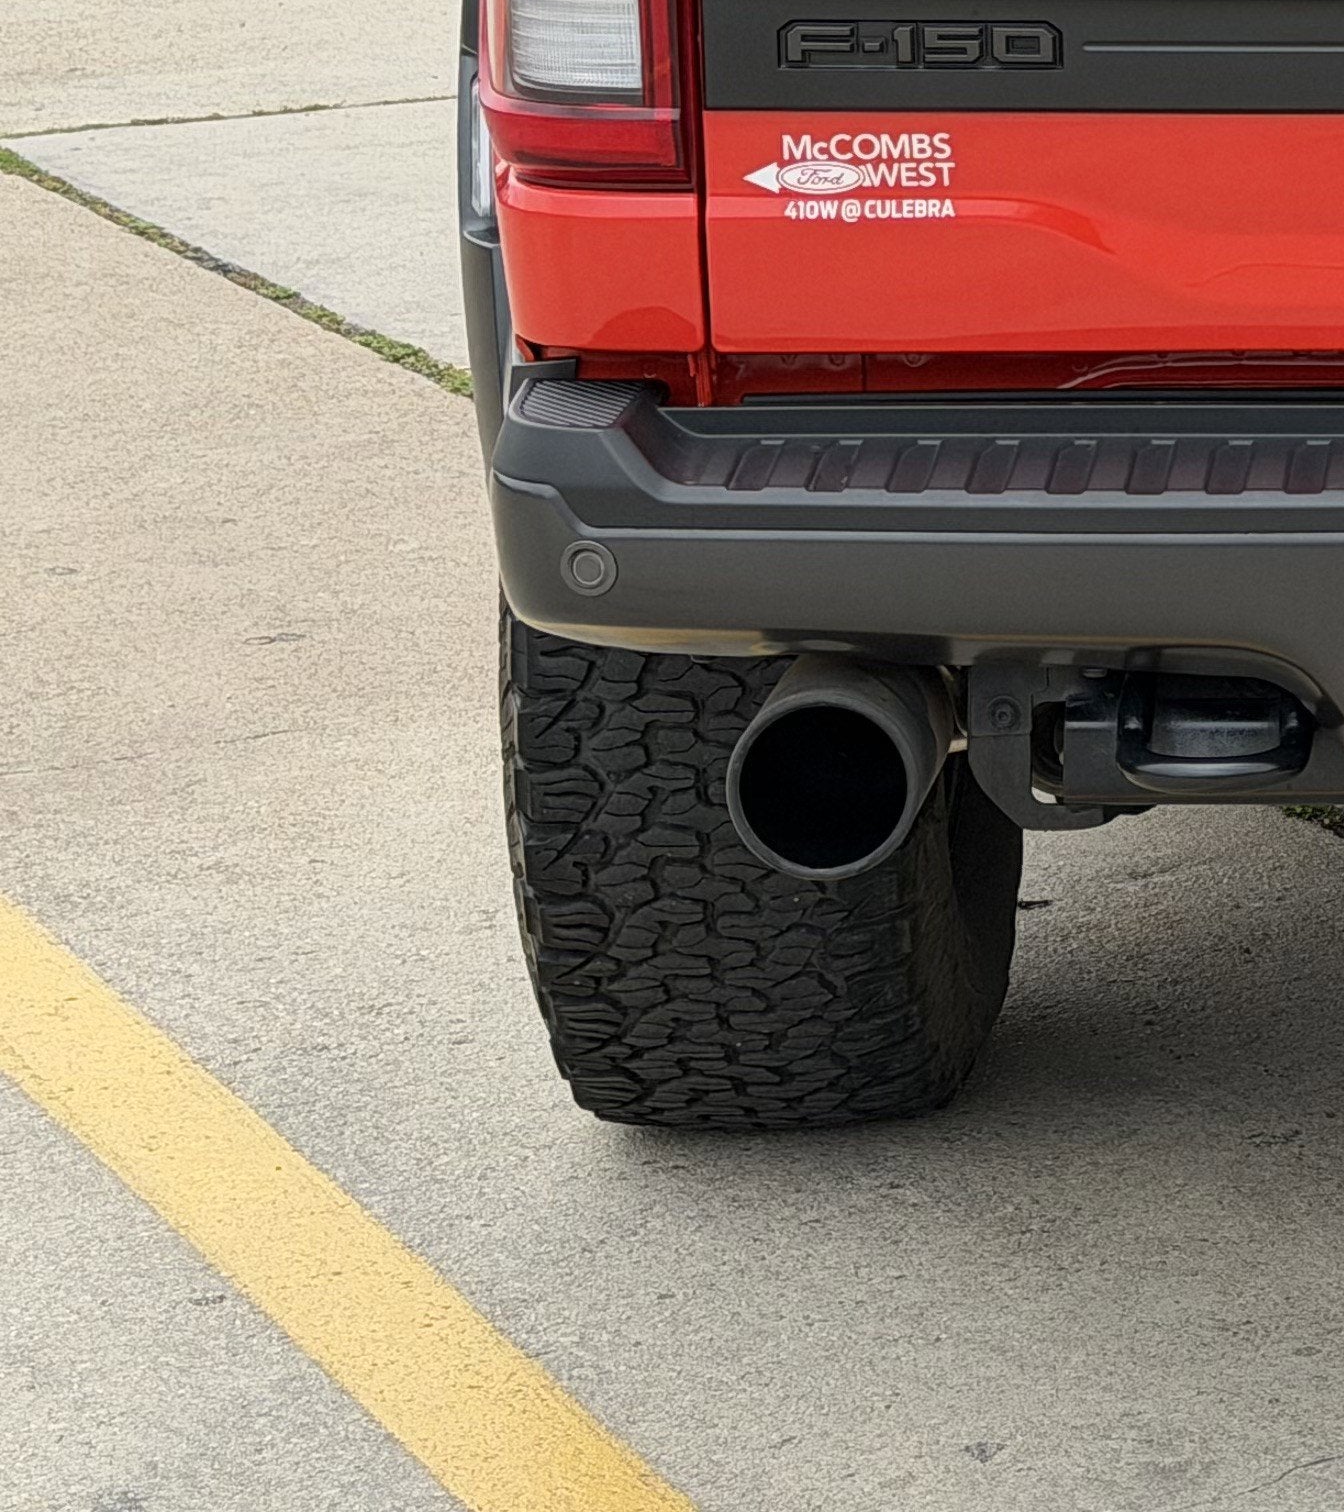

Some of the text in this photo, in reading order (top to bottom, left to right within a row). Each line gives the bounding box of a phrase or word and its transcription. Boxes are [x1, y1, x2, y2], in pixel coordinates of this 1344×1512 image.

[778, 20, 1063, 70] F-150
[781, 133, 951, 161] McCOMBS
[872, 162, 955, 187] WEST
